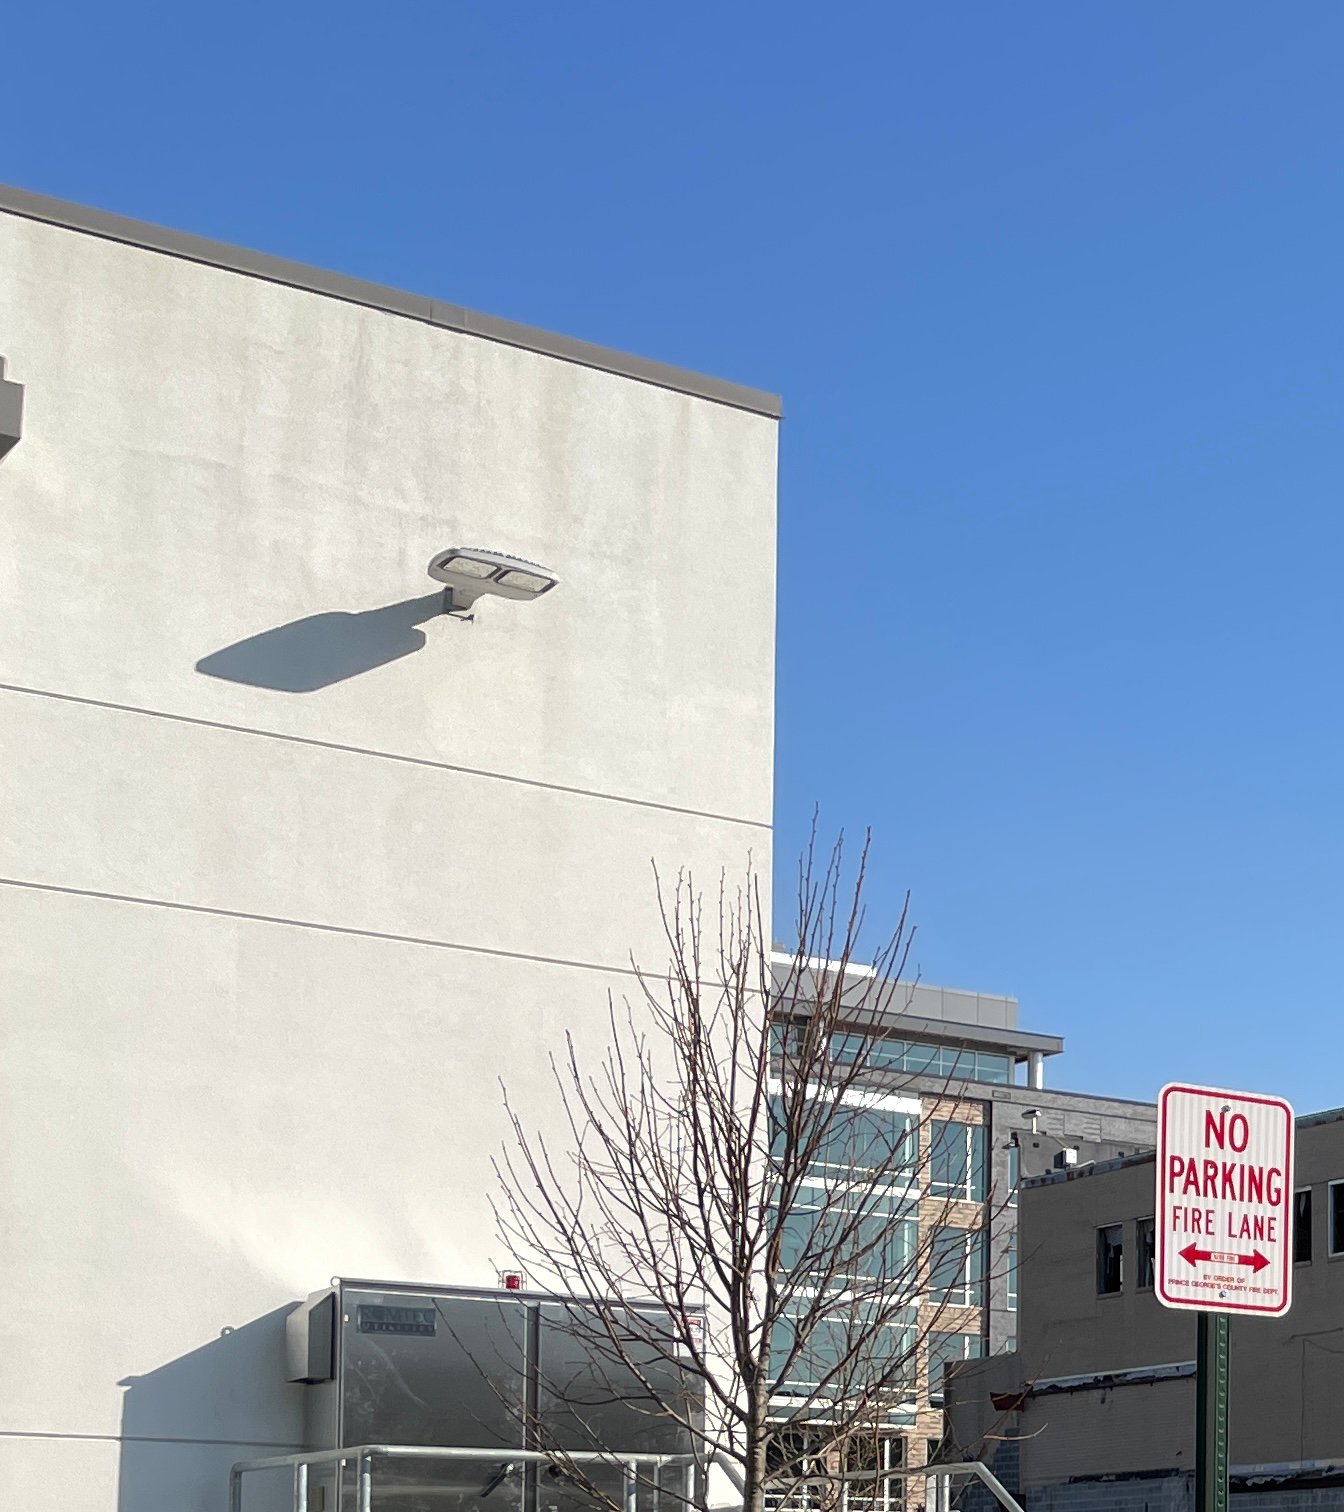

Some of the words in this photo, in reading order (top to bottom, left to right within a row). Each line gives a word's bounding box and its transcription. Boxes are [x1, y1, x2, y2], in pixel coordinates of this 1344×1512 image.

[1205, 1109, 1249, 1153] NO
[1169, 1155, 1282, 1207] PARKING
[1172, 1206, 1215, 1235] FIRE
[1228, 1211, 1277, 1243] LANE
[1213, 1275, 1234, 1283] ORDER
